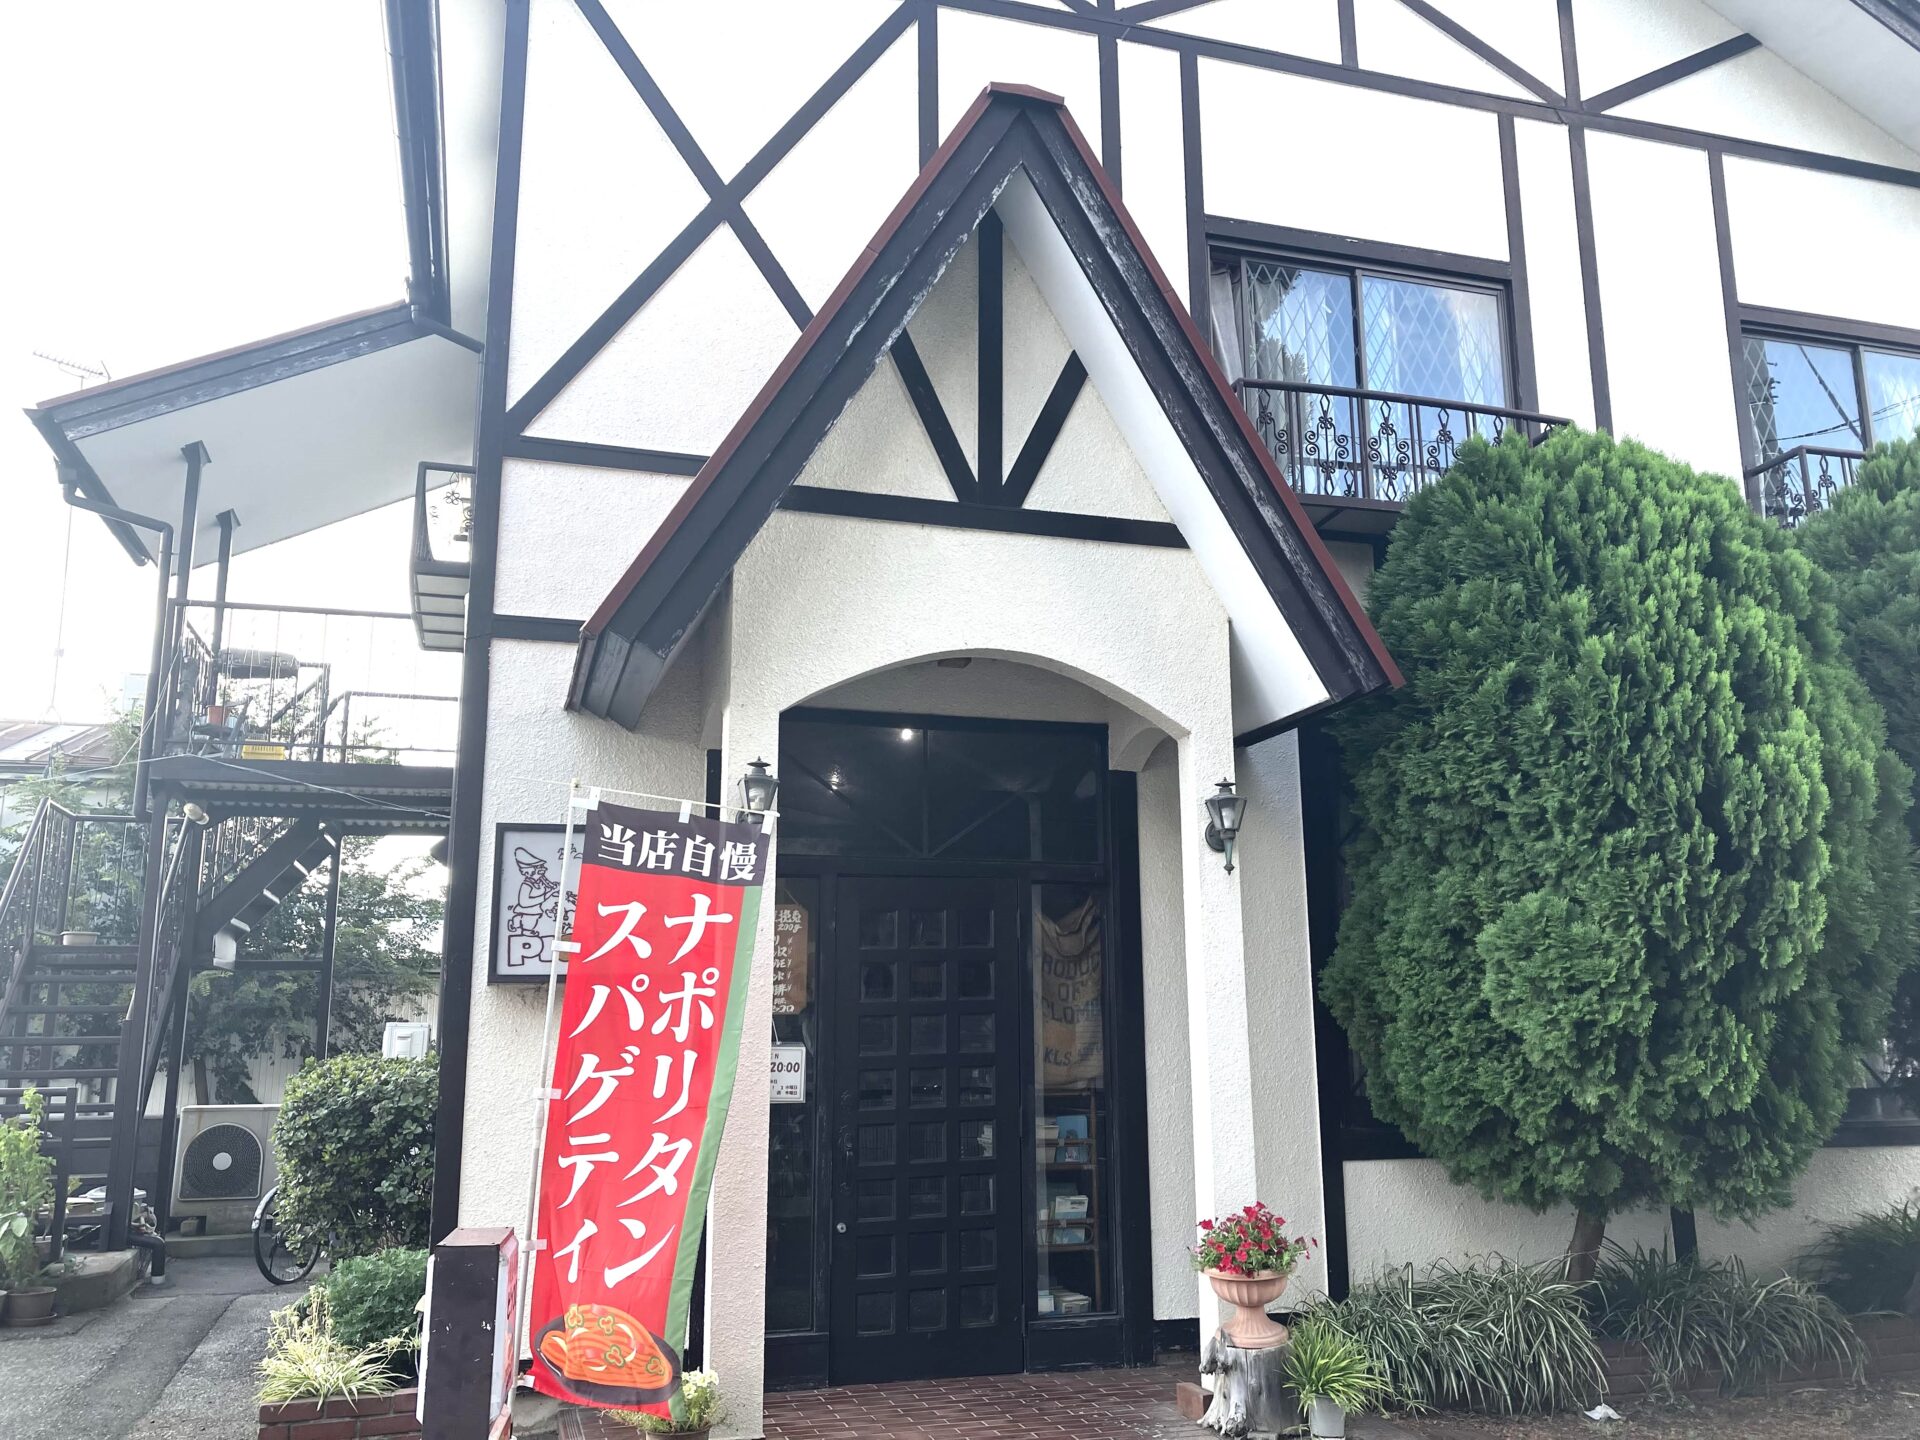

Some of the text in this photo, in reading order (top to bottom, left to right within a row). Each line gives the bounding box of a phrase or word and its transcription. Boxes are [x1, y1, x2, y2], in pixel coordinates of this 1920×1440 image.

[598, 822, 758, 882] 当店自慢
[603, 892, 734, 1289] ナポリタン
[770, 1061, 800, 1073] 20:00
